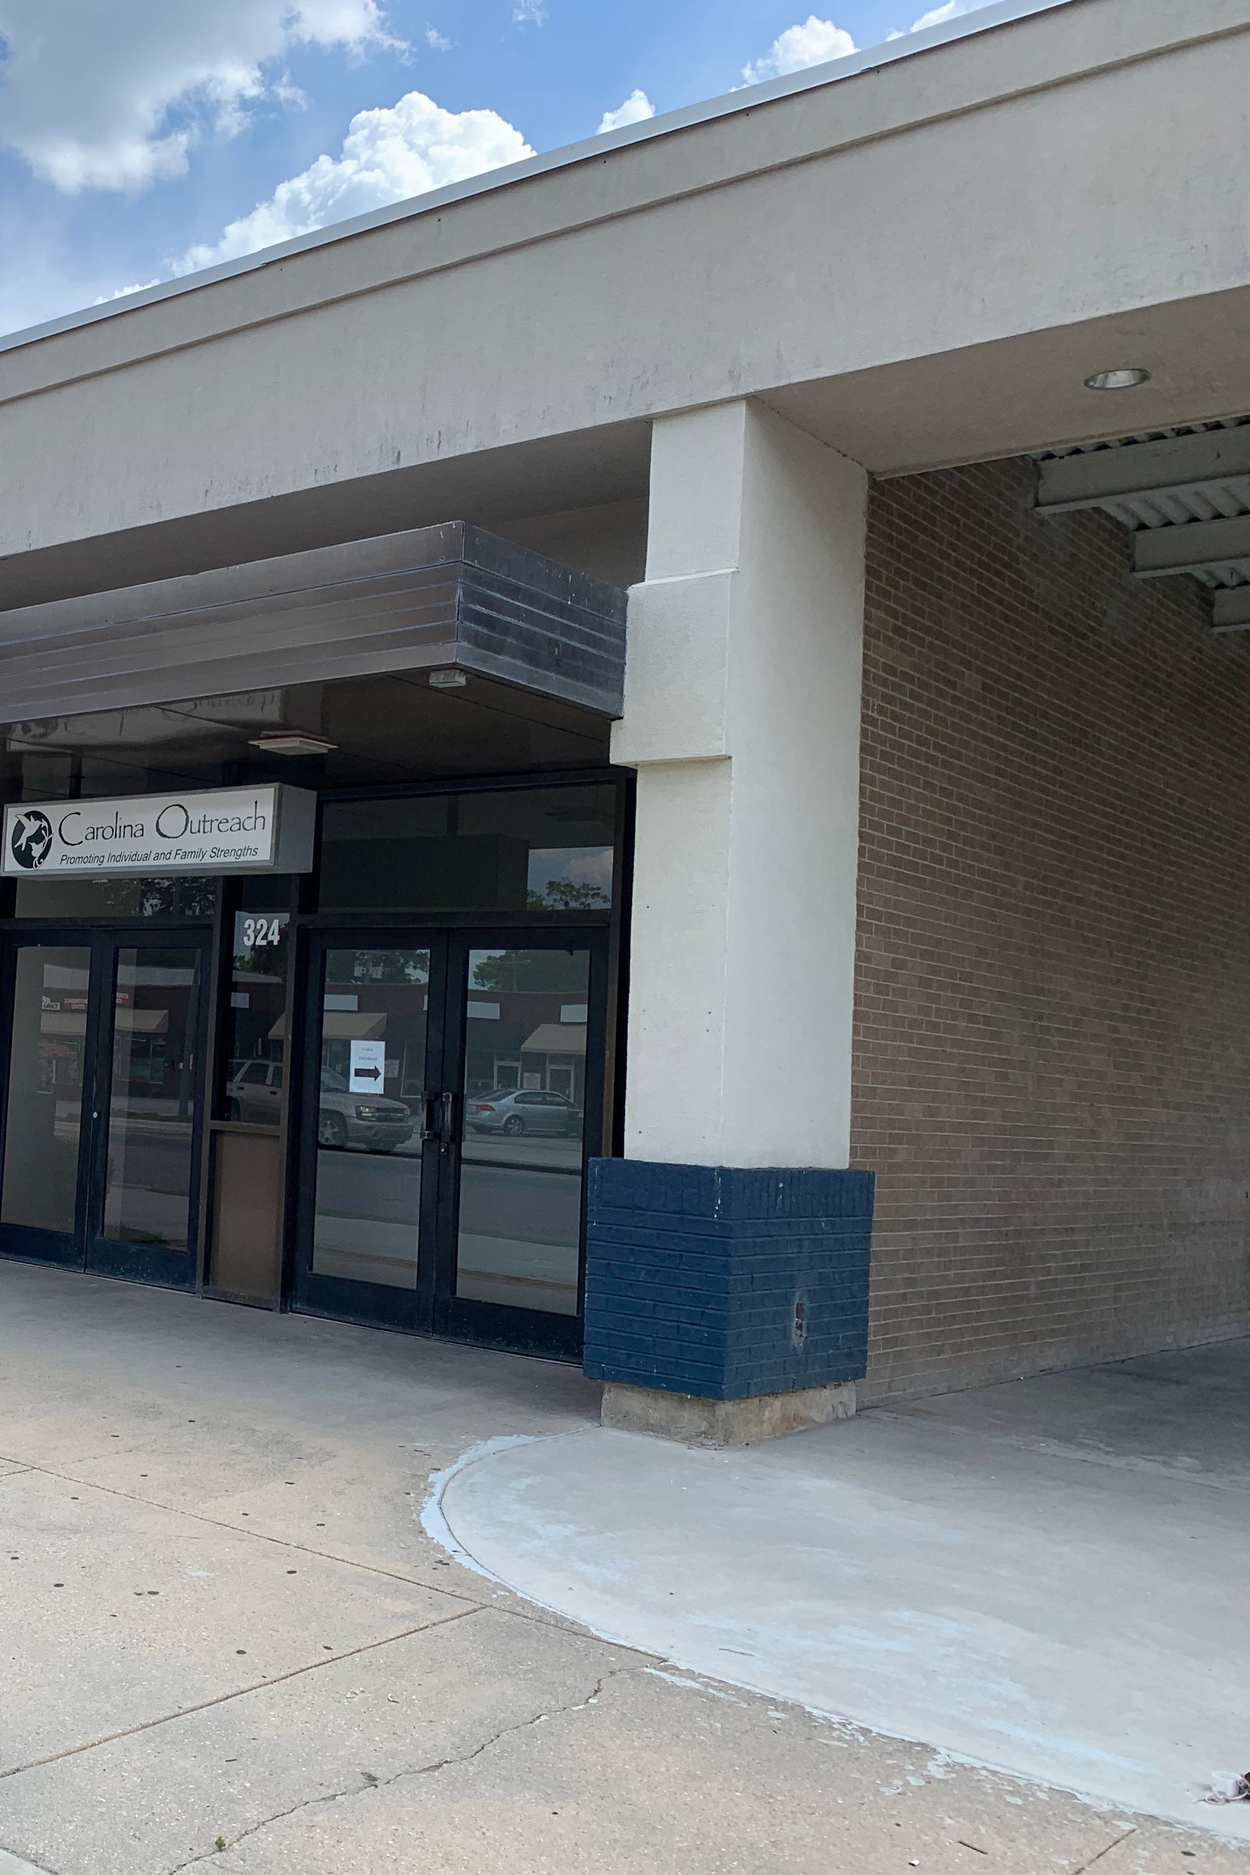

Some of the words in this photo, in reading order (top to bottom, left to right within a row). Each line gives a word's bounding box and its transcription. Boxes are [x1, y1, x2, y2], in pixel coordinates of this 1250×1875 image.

[58, 811, 145, 846] Carolina
[155, 800, 266, 839] Outreach
[59, 853, 106, 866] Promoting
[106, 850, 151, 863] Individual
[153, 850, 172, 861] and
[173, 847, 206, 862] Family
[208, 845, 259, 860] Strengths
[243, 918, 281, 946] 324
